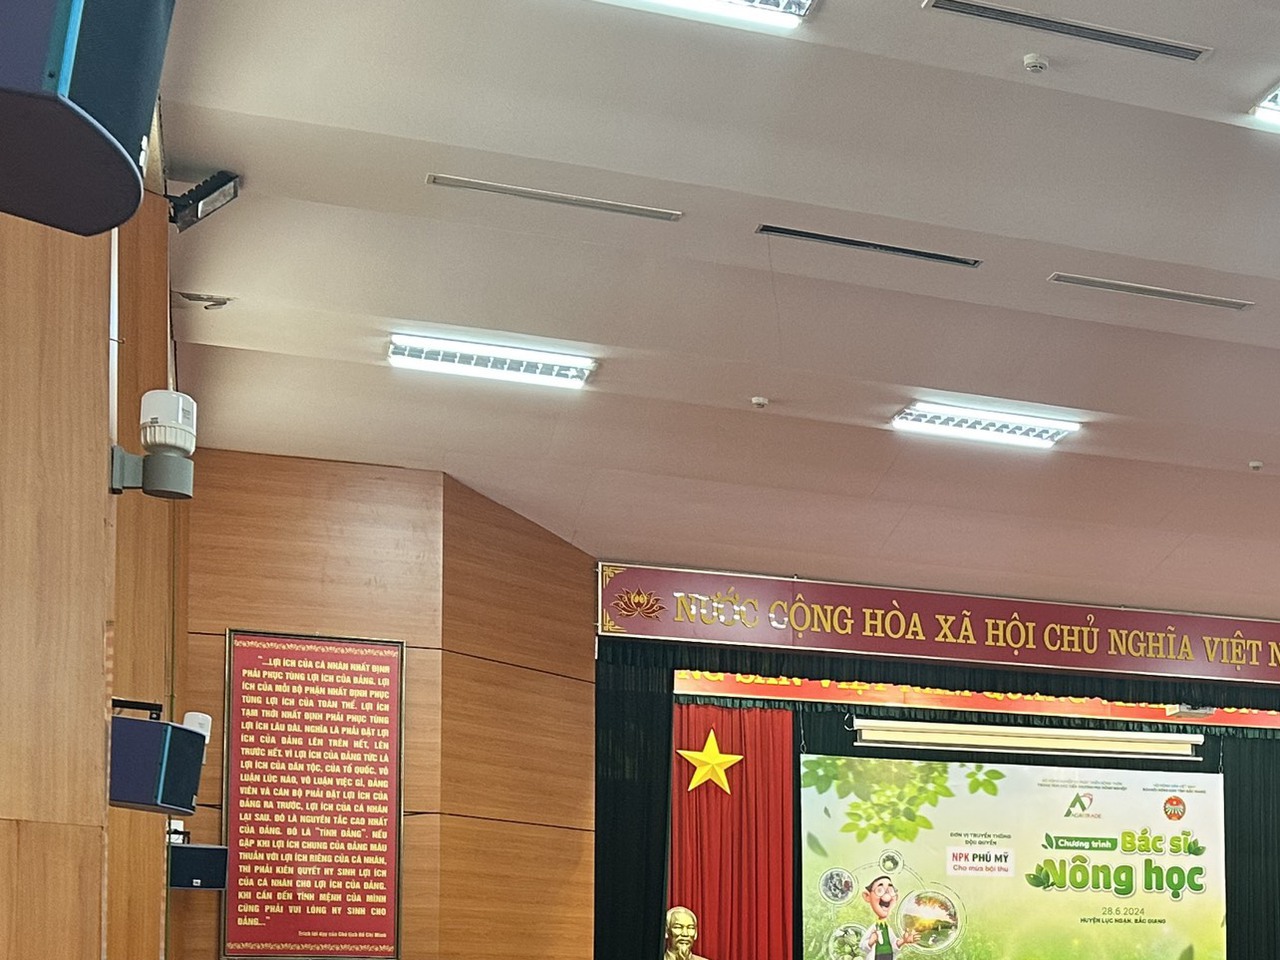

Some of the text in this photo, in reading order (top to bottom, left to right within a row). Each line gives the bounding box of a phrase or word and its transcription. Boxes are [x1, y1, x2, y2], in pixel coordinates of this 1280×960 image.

[673, 586, 758, 628] NƯỚC
[768, 594, 854, 639] CỘNG
[862, 600, 925, 640] HÒA
[935, 610, 976, 645] XÃ
[985, 612, 1036, 656] HỘI
[1043, 614, 1099, 654] CHỦ
[1108, 626, 1194, 661] NGHĨA
[1203, 630, 1262, 671] VIỆT
[1058, 828, 1191, 854] Chương trình Bác sĩ
[952, 851, 1009, 863] NPK PHÚ MỸ
[1043, 854, 1203, 899] Nông học
[1102, 907, 1145, 916] 28.6.2024
